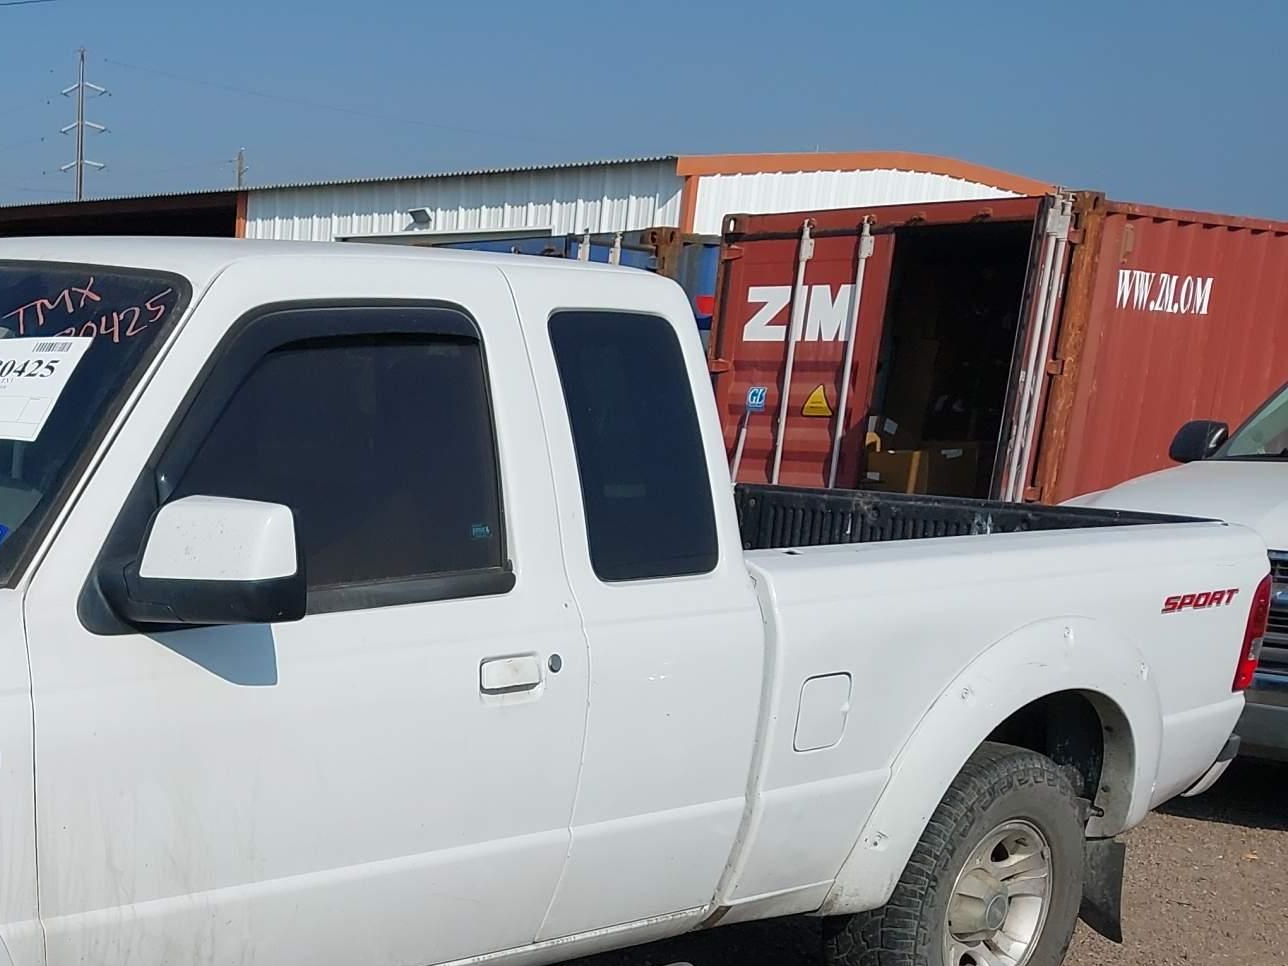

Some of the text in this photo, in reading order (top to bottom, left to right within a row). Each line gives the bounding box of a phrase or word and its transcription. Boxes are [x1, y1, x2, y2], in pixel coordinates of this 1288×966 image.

[1, 276, 101, 335] TMX
[742, 284, 856, 342] ZIM
[1160, 588, 1239, 614] SPORT
